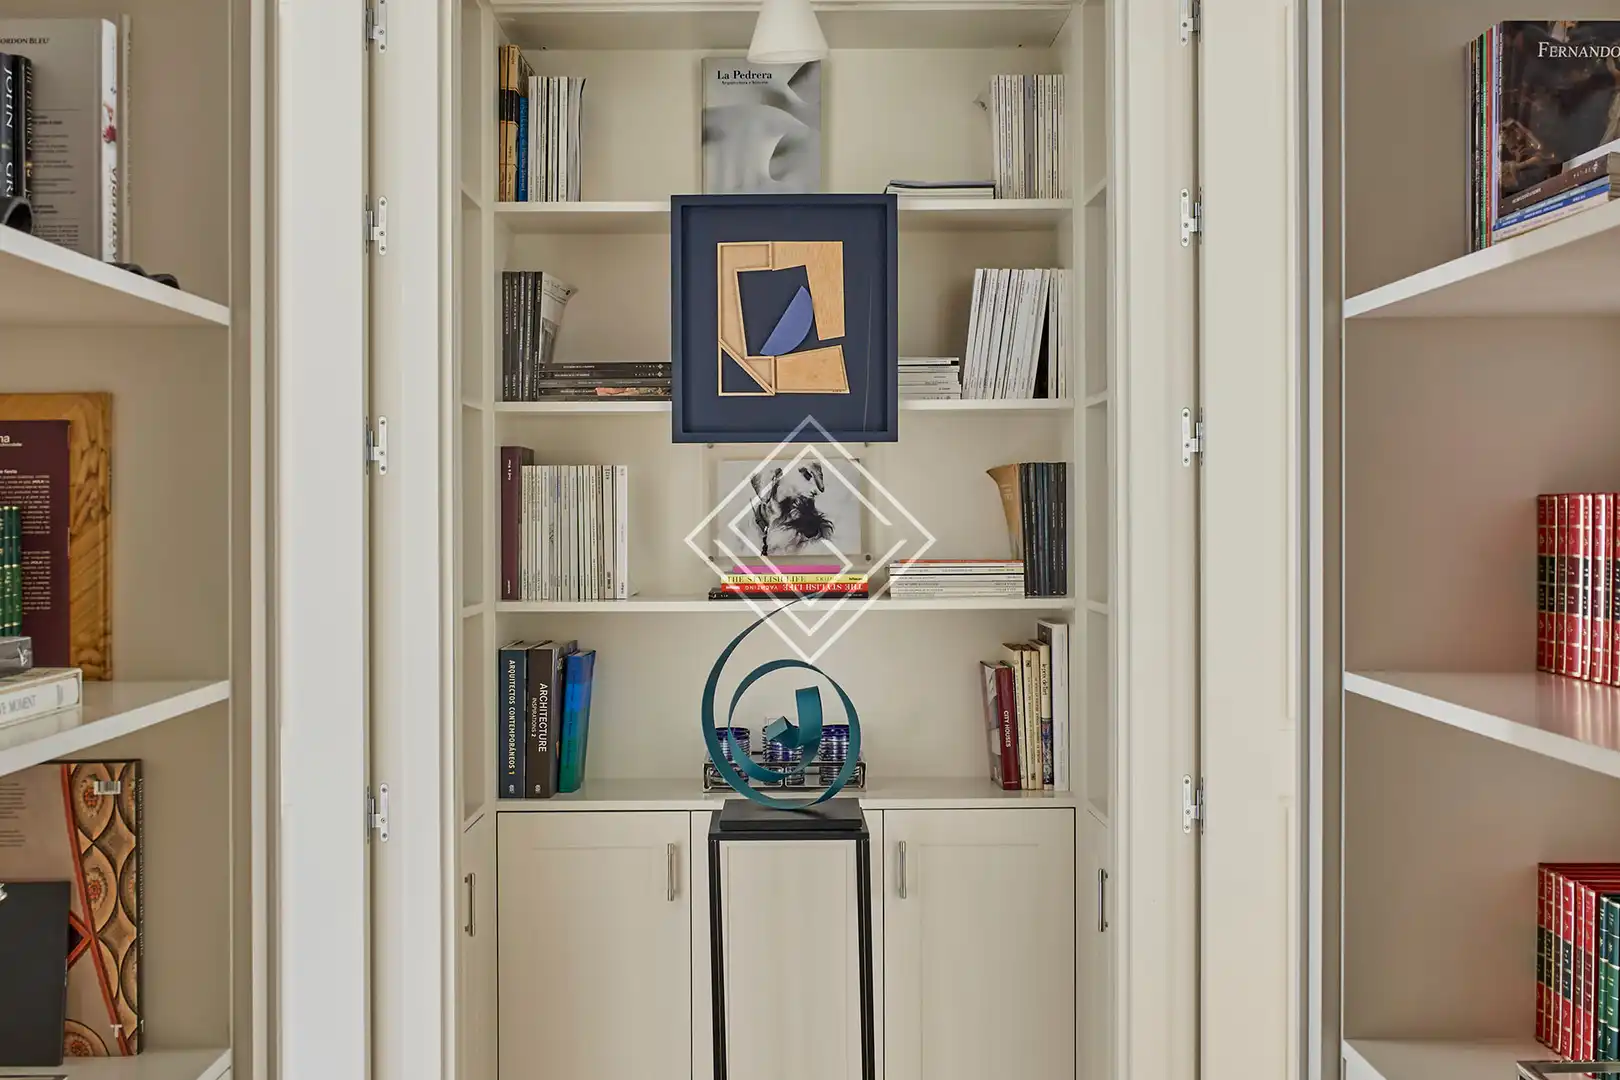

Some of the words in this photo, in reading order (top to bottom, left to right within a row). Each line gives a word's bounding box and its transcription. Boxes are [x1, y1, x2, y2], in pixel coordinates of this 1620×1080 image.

[1537, 41, 1620, 59] FERNANDO
[717, 70, 729, 80] La
[733, 70, 772, 80] Pedrera
[4, 66, 13, 129] JOHN
[782, 583, 802, 591] LIFE
[807, 583, 842, 591] STYLISH
[847, 583, 863, 591] THE
[508, 660, 516, 704] ARQUITECTOS
[538, 682, 548, 752] ARCHITECTURE
[508, 706, 516, 769] CONTEMPORÁNEOS
[1003, 724, 1012, 748] HOUSES
